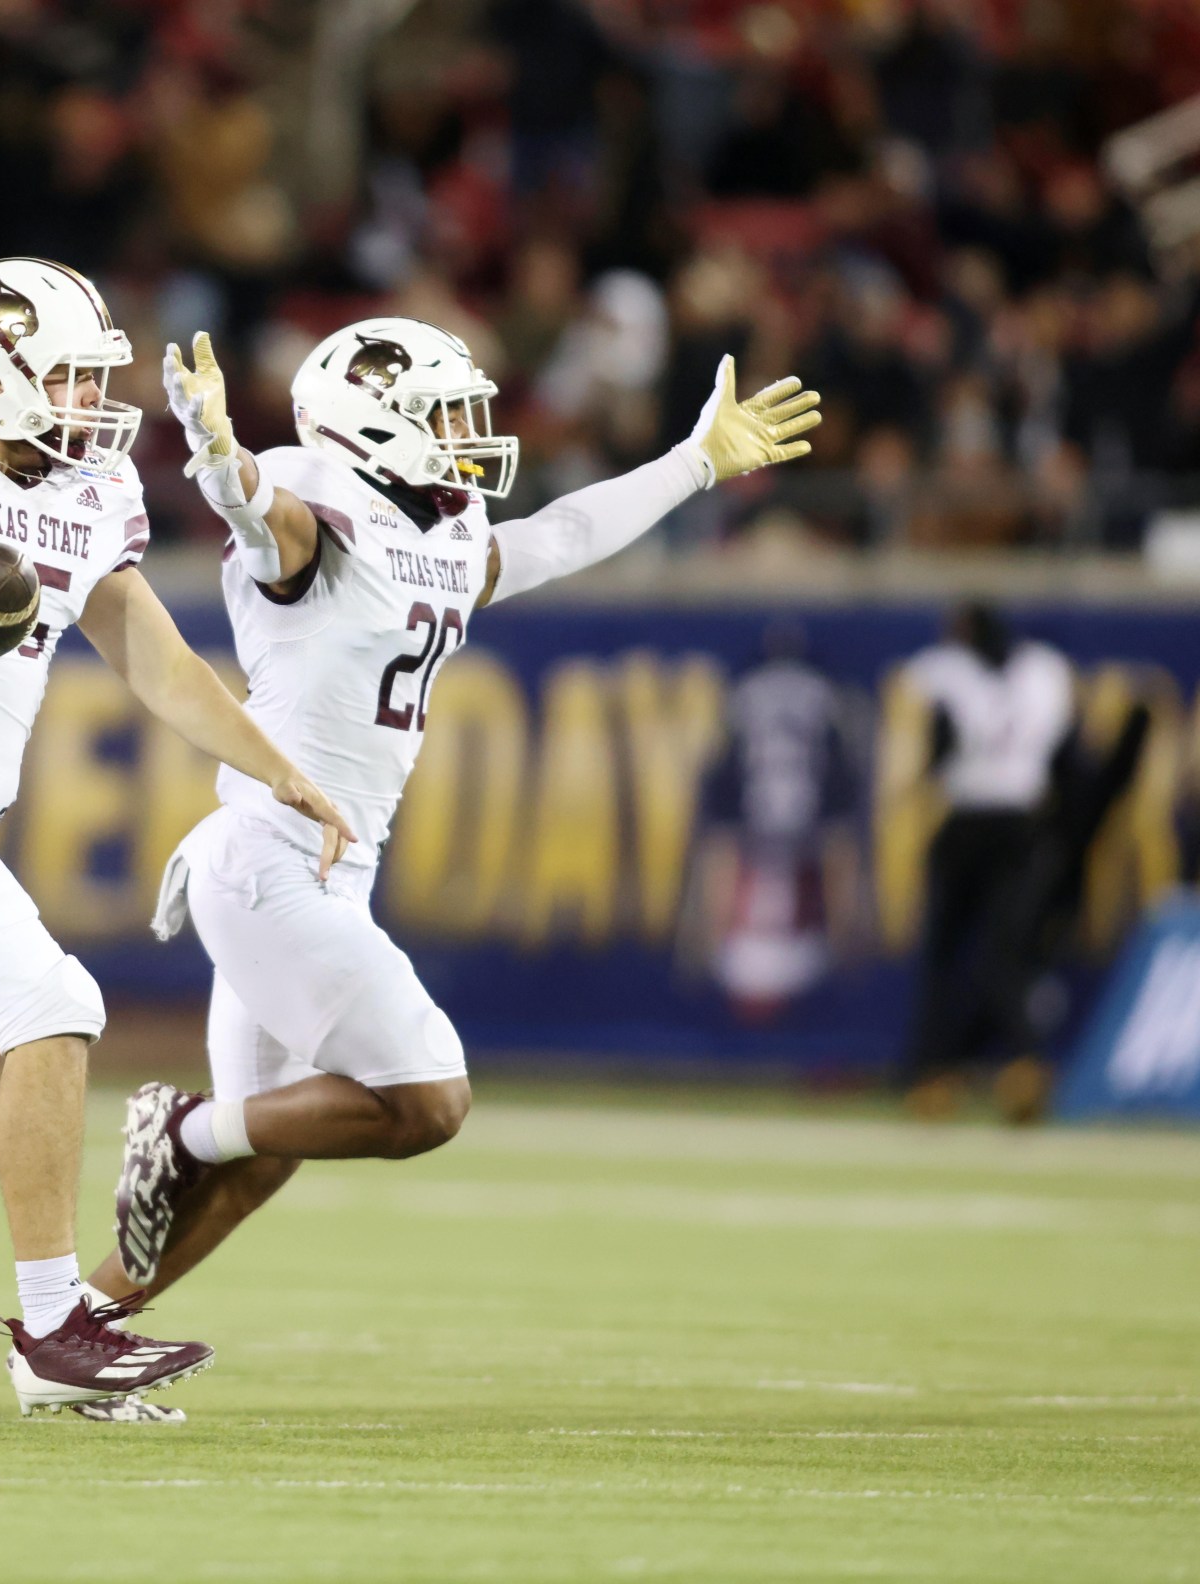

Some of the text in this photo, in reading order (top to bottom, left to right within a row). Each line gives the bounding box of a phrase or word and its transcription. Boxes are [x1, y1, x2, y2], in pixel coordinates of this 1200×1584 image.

[76, 497, 103, 511] adidas
[369, 499, 398, 529] SBC
[38, 513, 92, 560] STATE
[450, 532, 473, 541] adidas
[386, 547, 470, 594] TEXAS STATE
